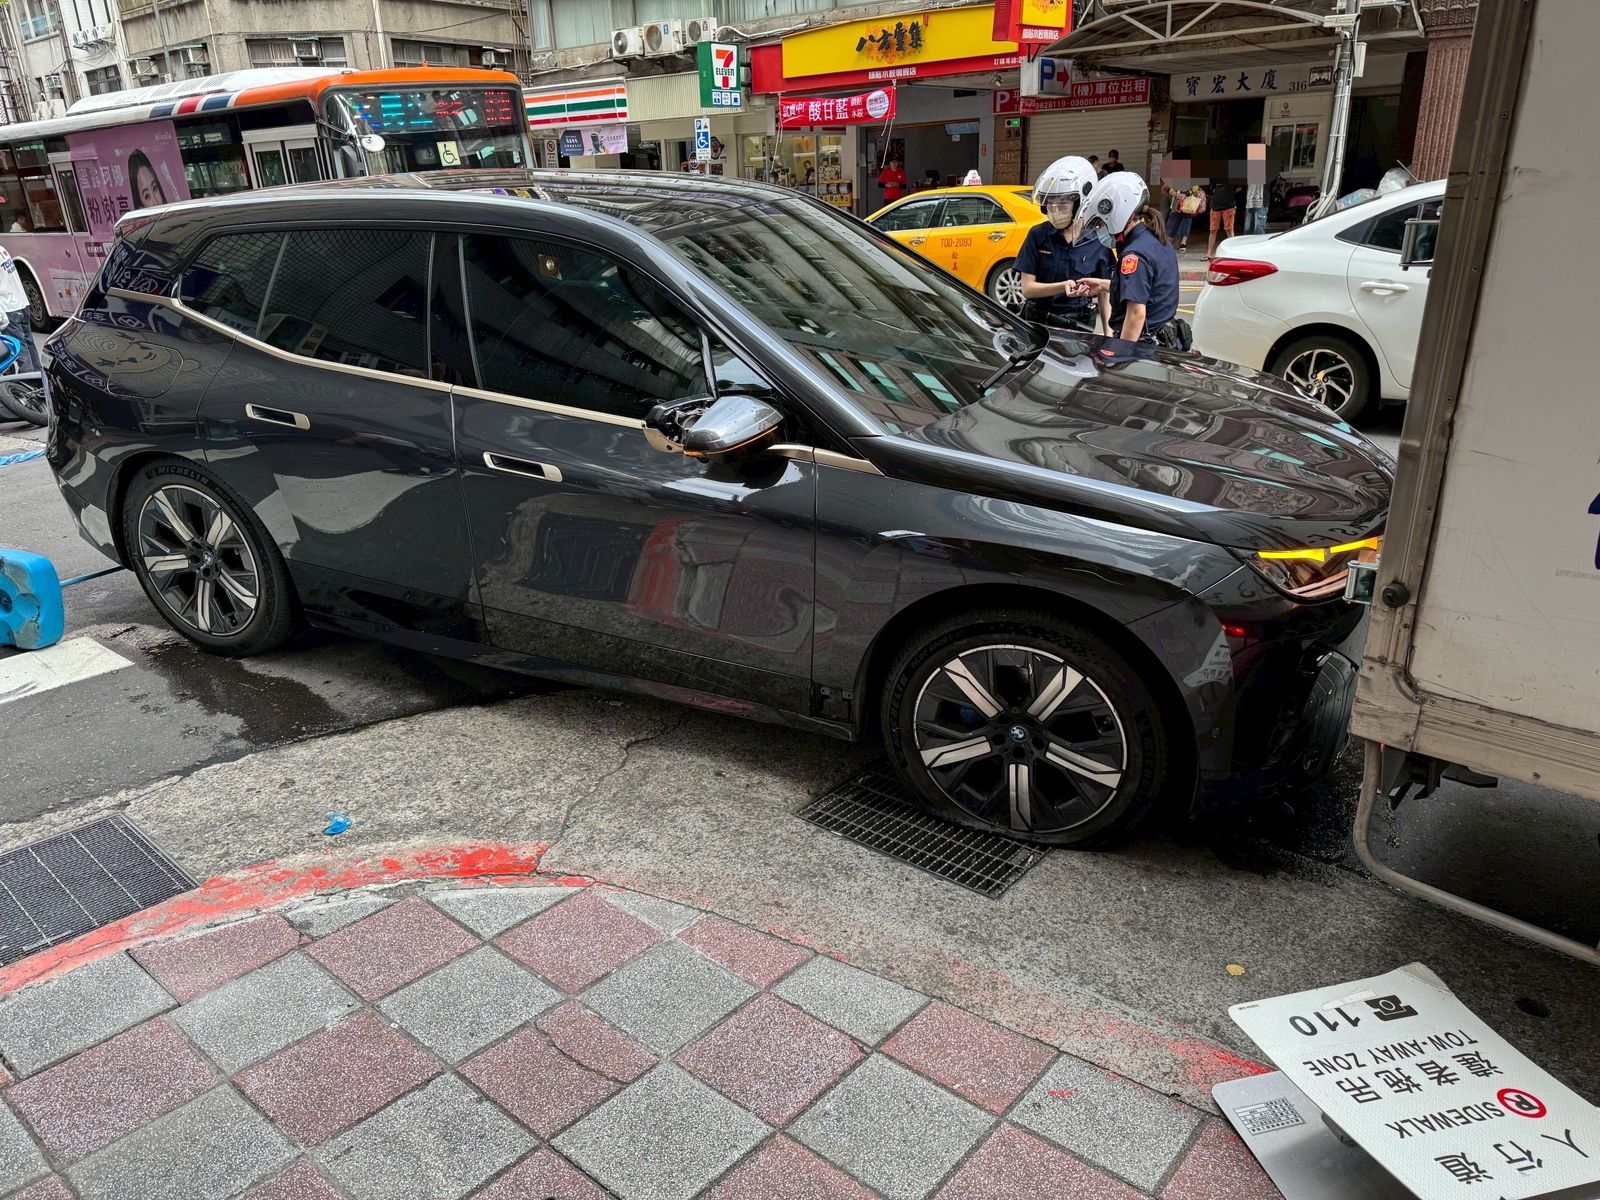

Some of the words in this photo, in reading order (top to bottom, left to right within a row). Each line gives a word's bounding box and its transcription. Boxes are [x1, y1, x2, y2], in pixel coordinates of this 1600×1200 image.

[856, 21, 922, 52] 八方雲集
[1040, 58, 1055, 91] P
[1186, 69, 1278, 96] 寶宏大廈
[1289, 80, 1307, 92] 316
[808, 97, 849, 122] 酸甘藍
[851, 108, 864, 118] 水餃
[996, 91, 1010, 112] P
[158, 466, 209, 484] MICHELIN
[1289, 1007, 1360, 1036] 110
[1367, 1030, 1479, 1064] TOW-AWAY
[1302, 1053, 1367, 1076] ZONE
[1335, 1051, 1503, 1104] 違者拖吊
[1384, 1101, 1505, 1139] SIDEWALK
[1434, 1128, 1589, 1185] 人行道
